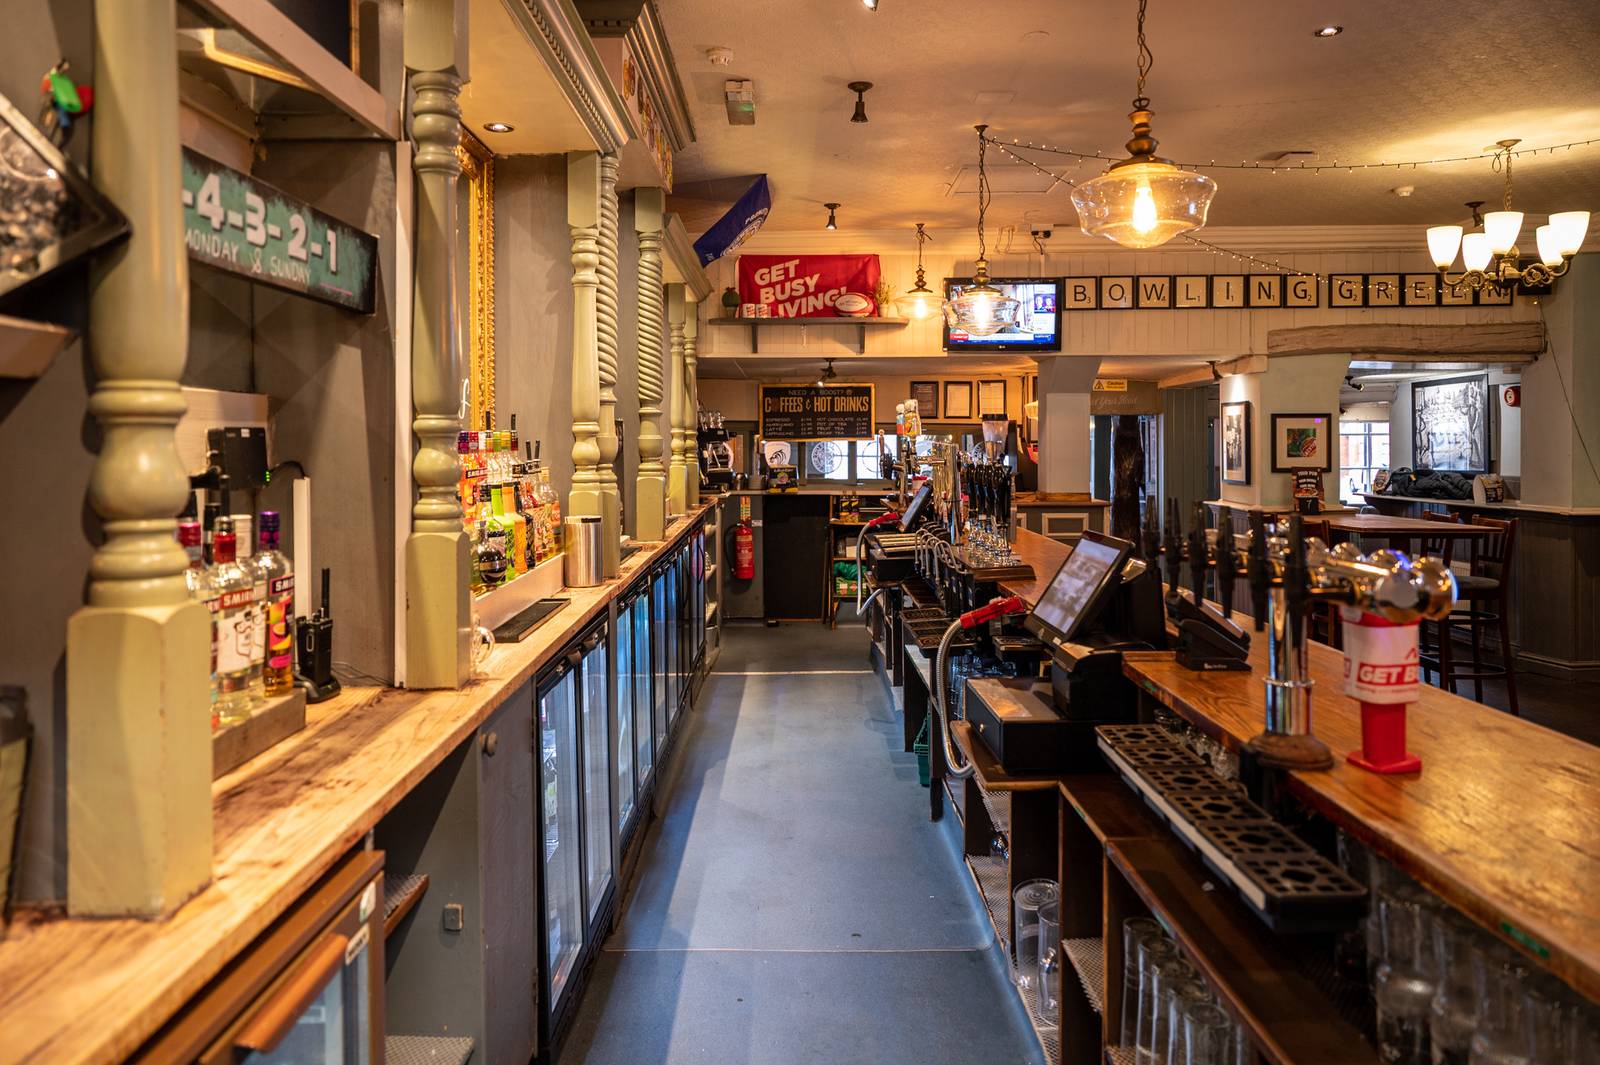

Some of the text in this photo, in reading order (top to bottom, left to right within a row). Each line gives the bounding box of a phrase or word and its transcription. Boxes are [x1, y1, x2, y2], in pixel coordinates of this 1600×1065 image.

[270, 256, 311, 283] SUNDAY
[754, 259, 800, 286] GET
[759, 273, 821, 304] BUSY
[771, 286, 847, 318] IVING
[813, 397, 832, 412] HOT
[834, 397, 869, 412] DRINKS
[1359, 666, 1401, 684] GET
